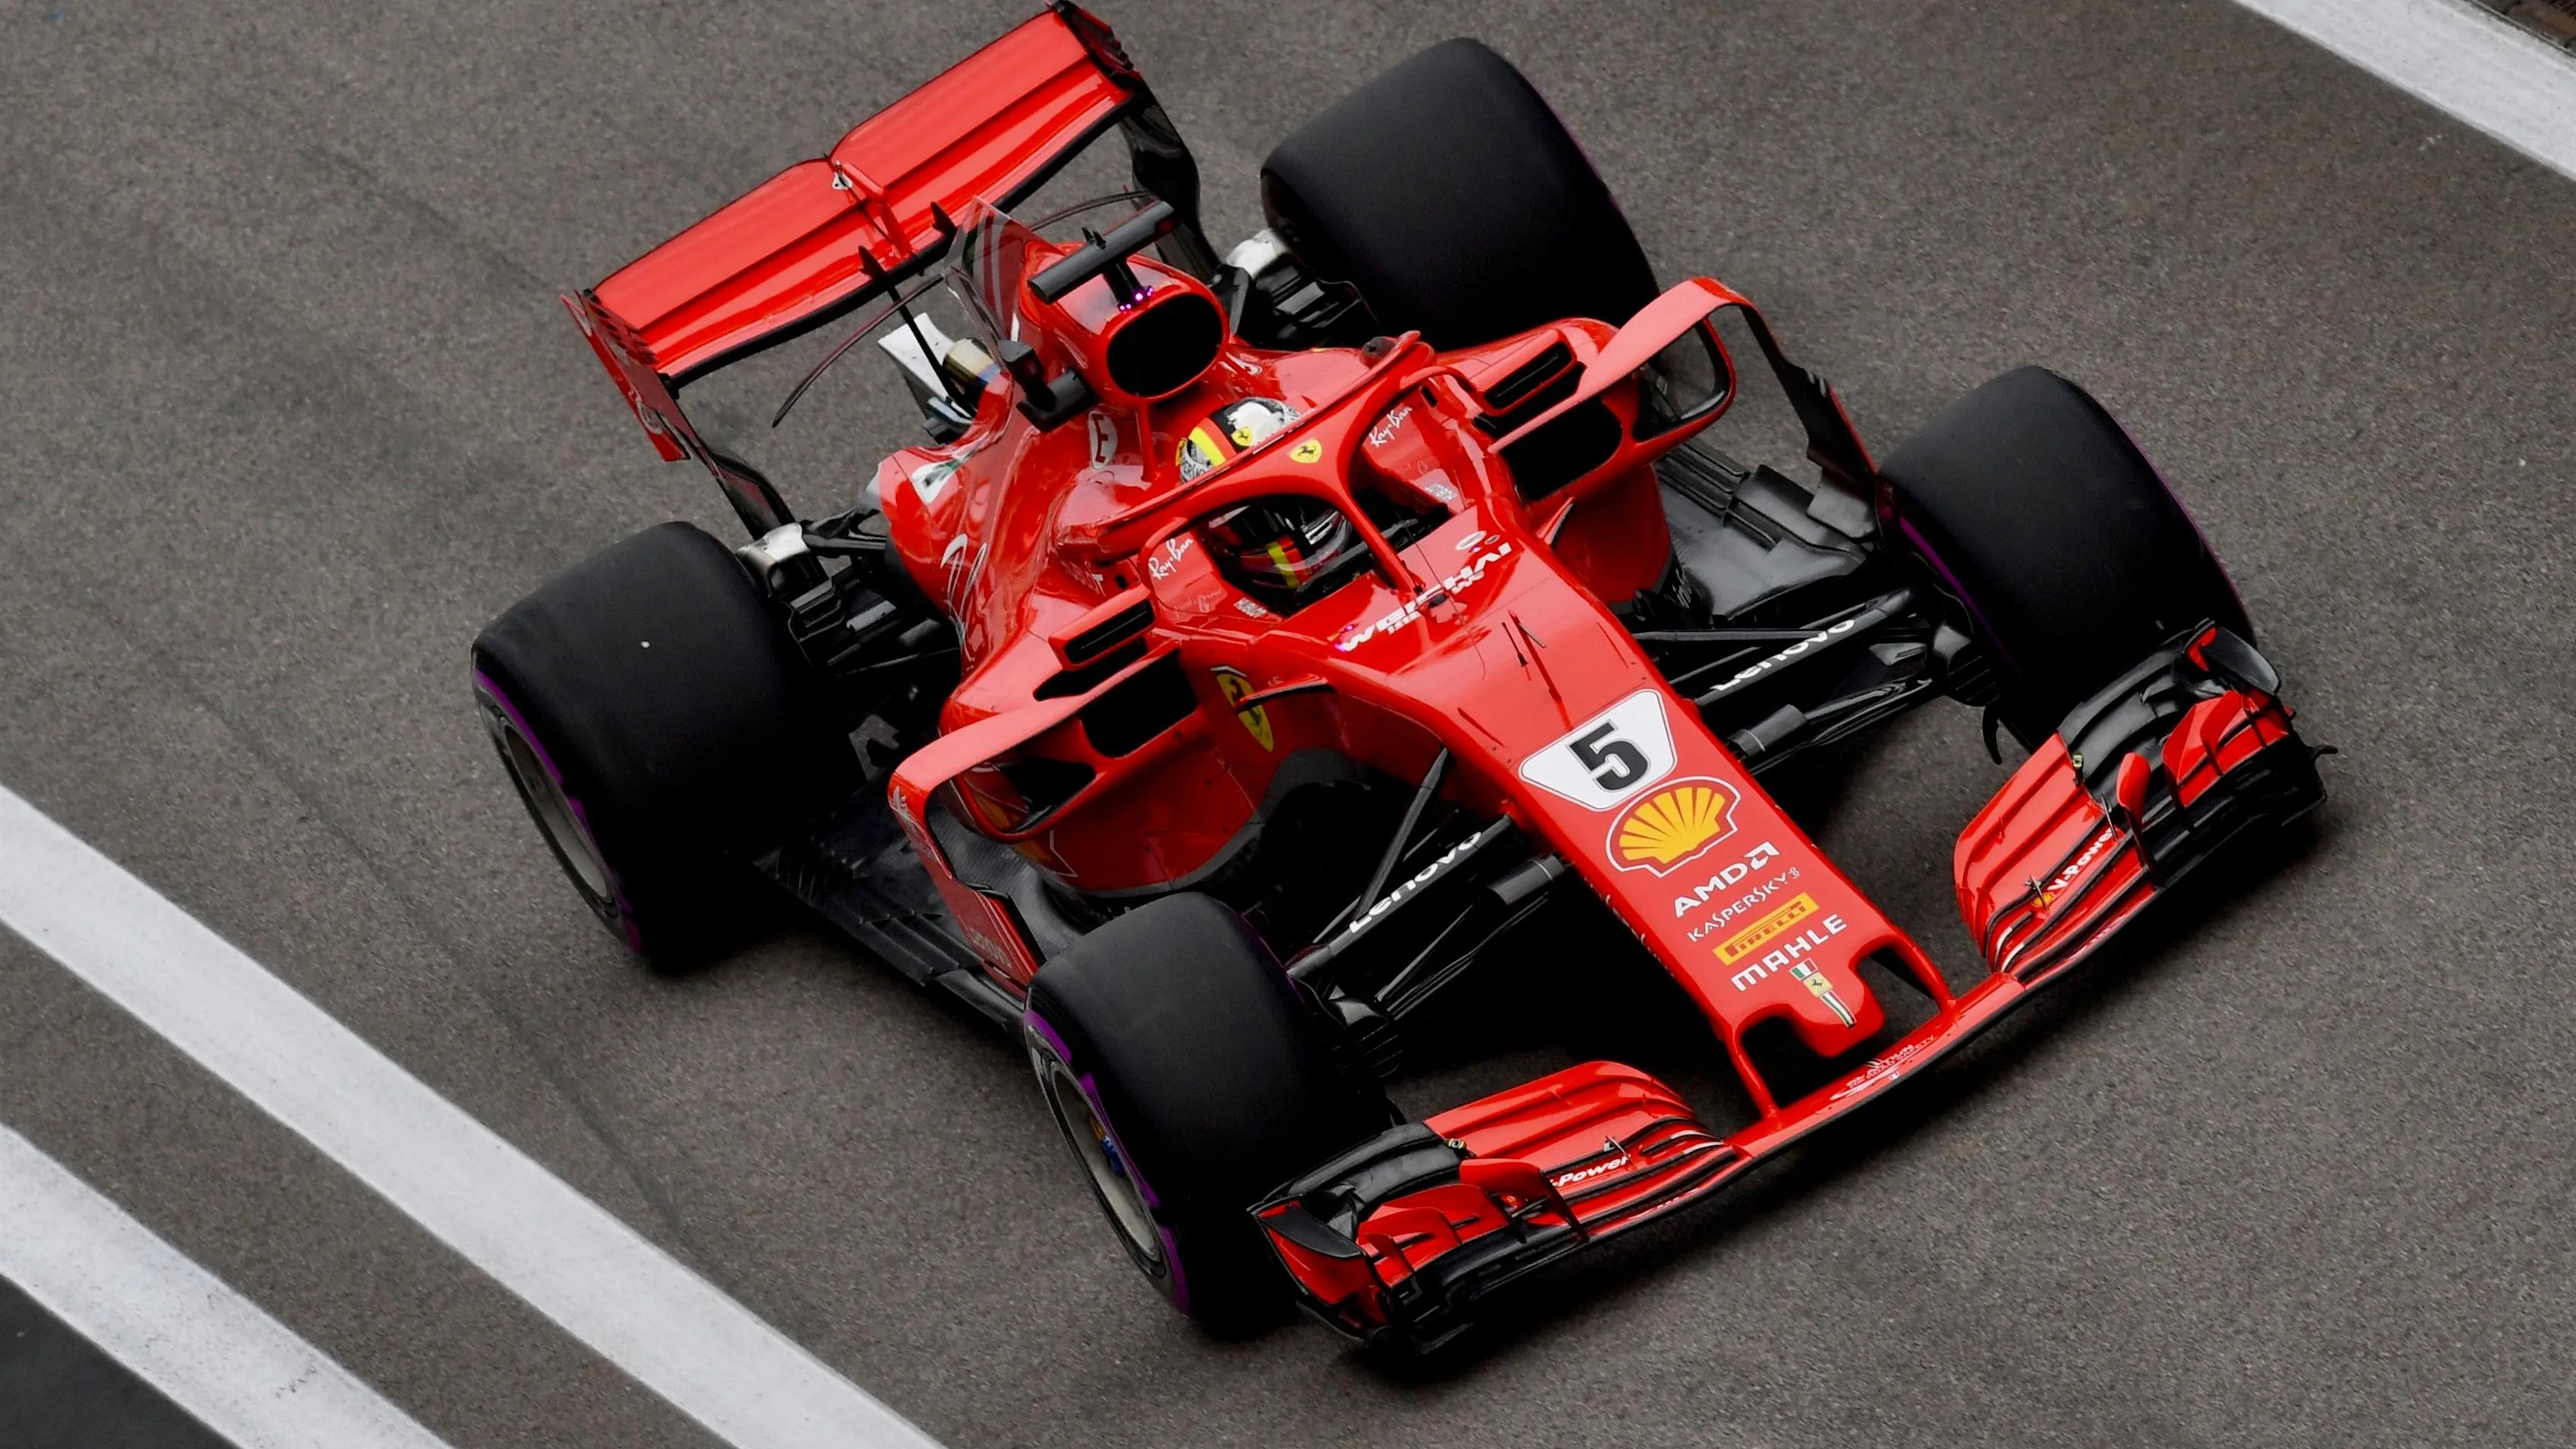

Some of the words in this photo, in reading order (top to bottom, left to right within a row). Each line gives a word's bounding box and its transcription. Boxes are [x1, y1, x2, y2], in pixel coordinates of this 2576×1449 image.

[1566, 719, 1651, 793] 5
[1349, 832, 1482, 933] Lenovo
[1674, 863, 1749, 918] AMD
[1687, 873, 1789, 942] KASPERSKY
[1724, 901, 1807, 958] PIRELLI
[1731, 914, 1847, 992] MAHLE
[1550, 1154, 1632, 1187] -Power
